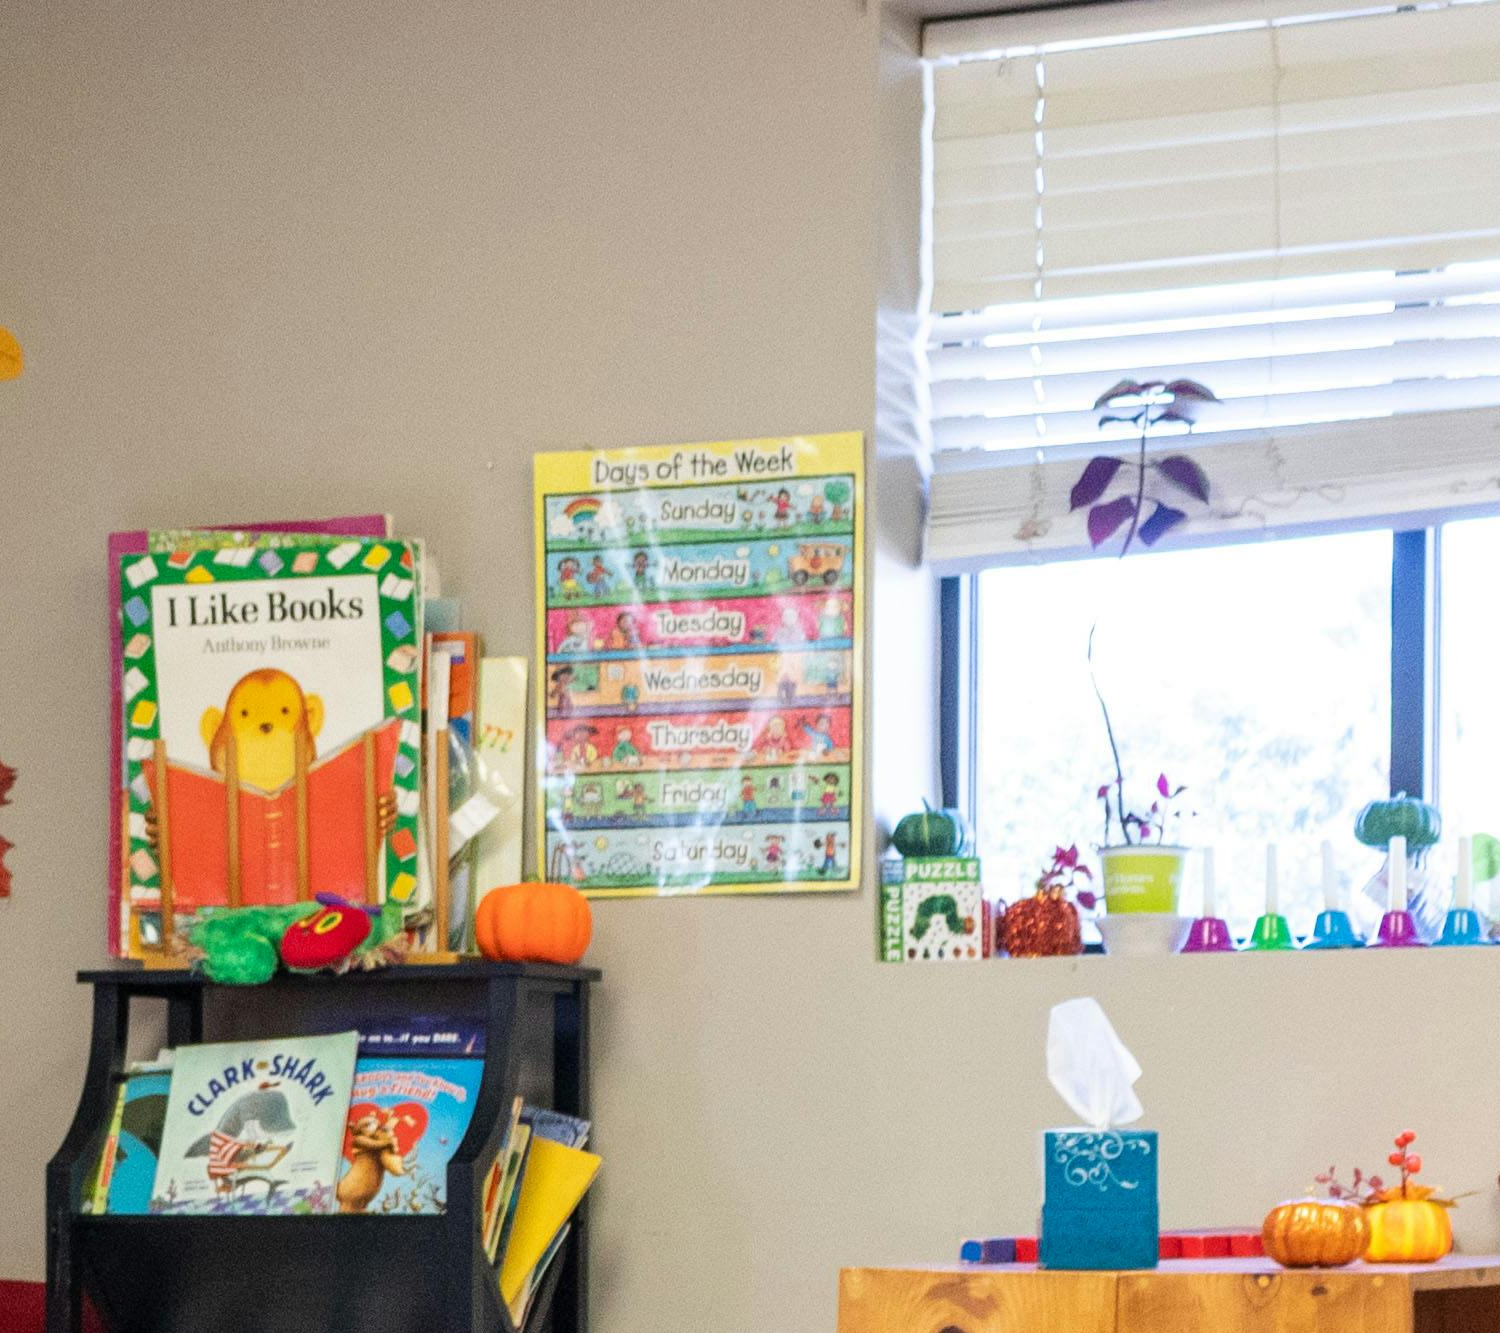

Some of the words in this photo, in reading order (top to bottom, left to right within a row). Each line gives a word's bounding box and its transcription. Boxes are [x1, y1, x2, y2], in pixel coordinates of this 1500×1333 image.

[594, 458, 650, 486] Days
[656, 453, 685, 478] of
[689, 450, 728, 477] the
[734, 449, 794, 474] Week
[660, 500, 735, 525] Sunday
[664, 559, 749, 586] Monday
[167, 597, 178, 627] I
[189, 593, 259, 627] Like
[266, 587, 364, 622] Books
[657, 610, 743, 637] Tuesday
[201, 635, 267, 659] Anthony
[270, 634, 331, 652] Browne
[643, 667, 762, 693] Wednesday
[650, 721, 751, 749] Thursday
[661, 780, 728, 806] Friday
[651, 839, 749, 865] Saturday
[906, 862, 978, 879] PUZZLE
[188, 1058, 255, 1116] CLARK
[269, 1053, 334, 1106] SHARK
